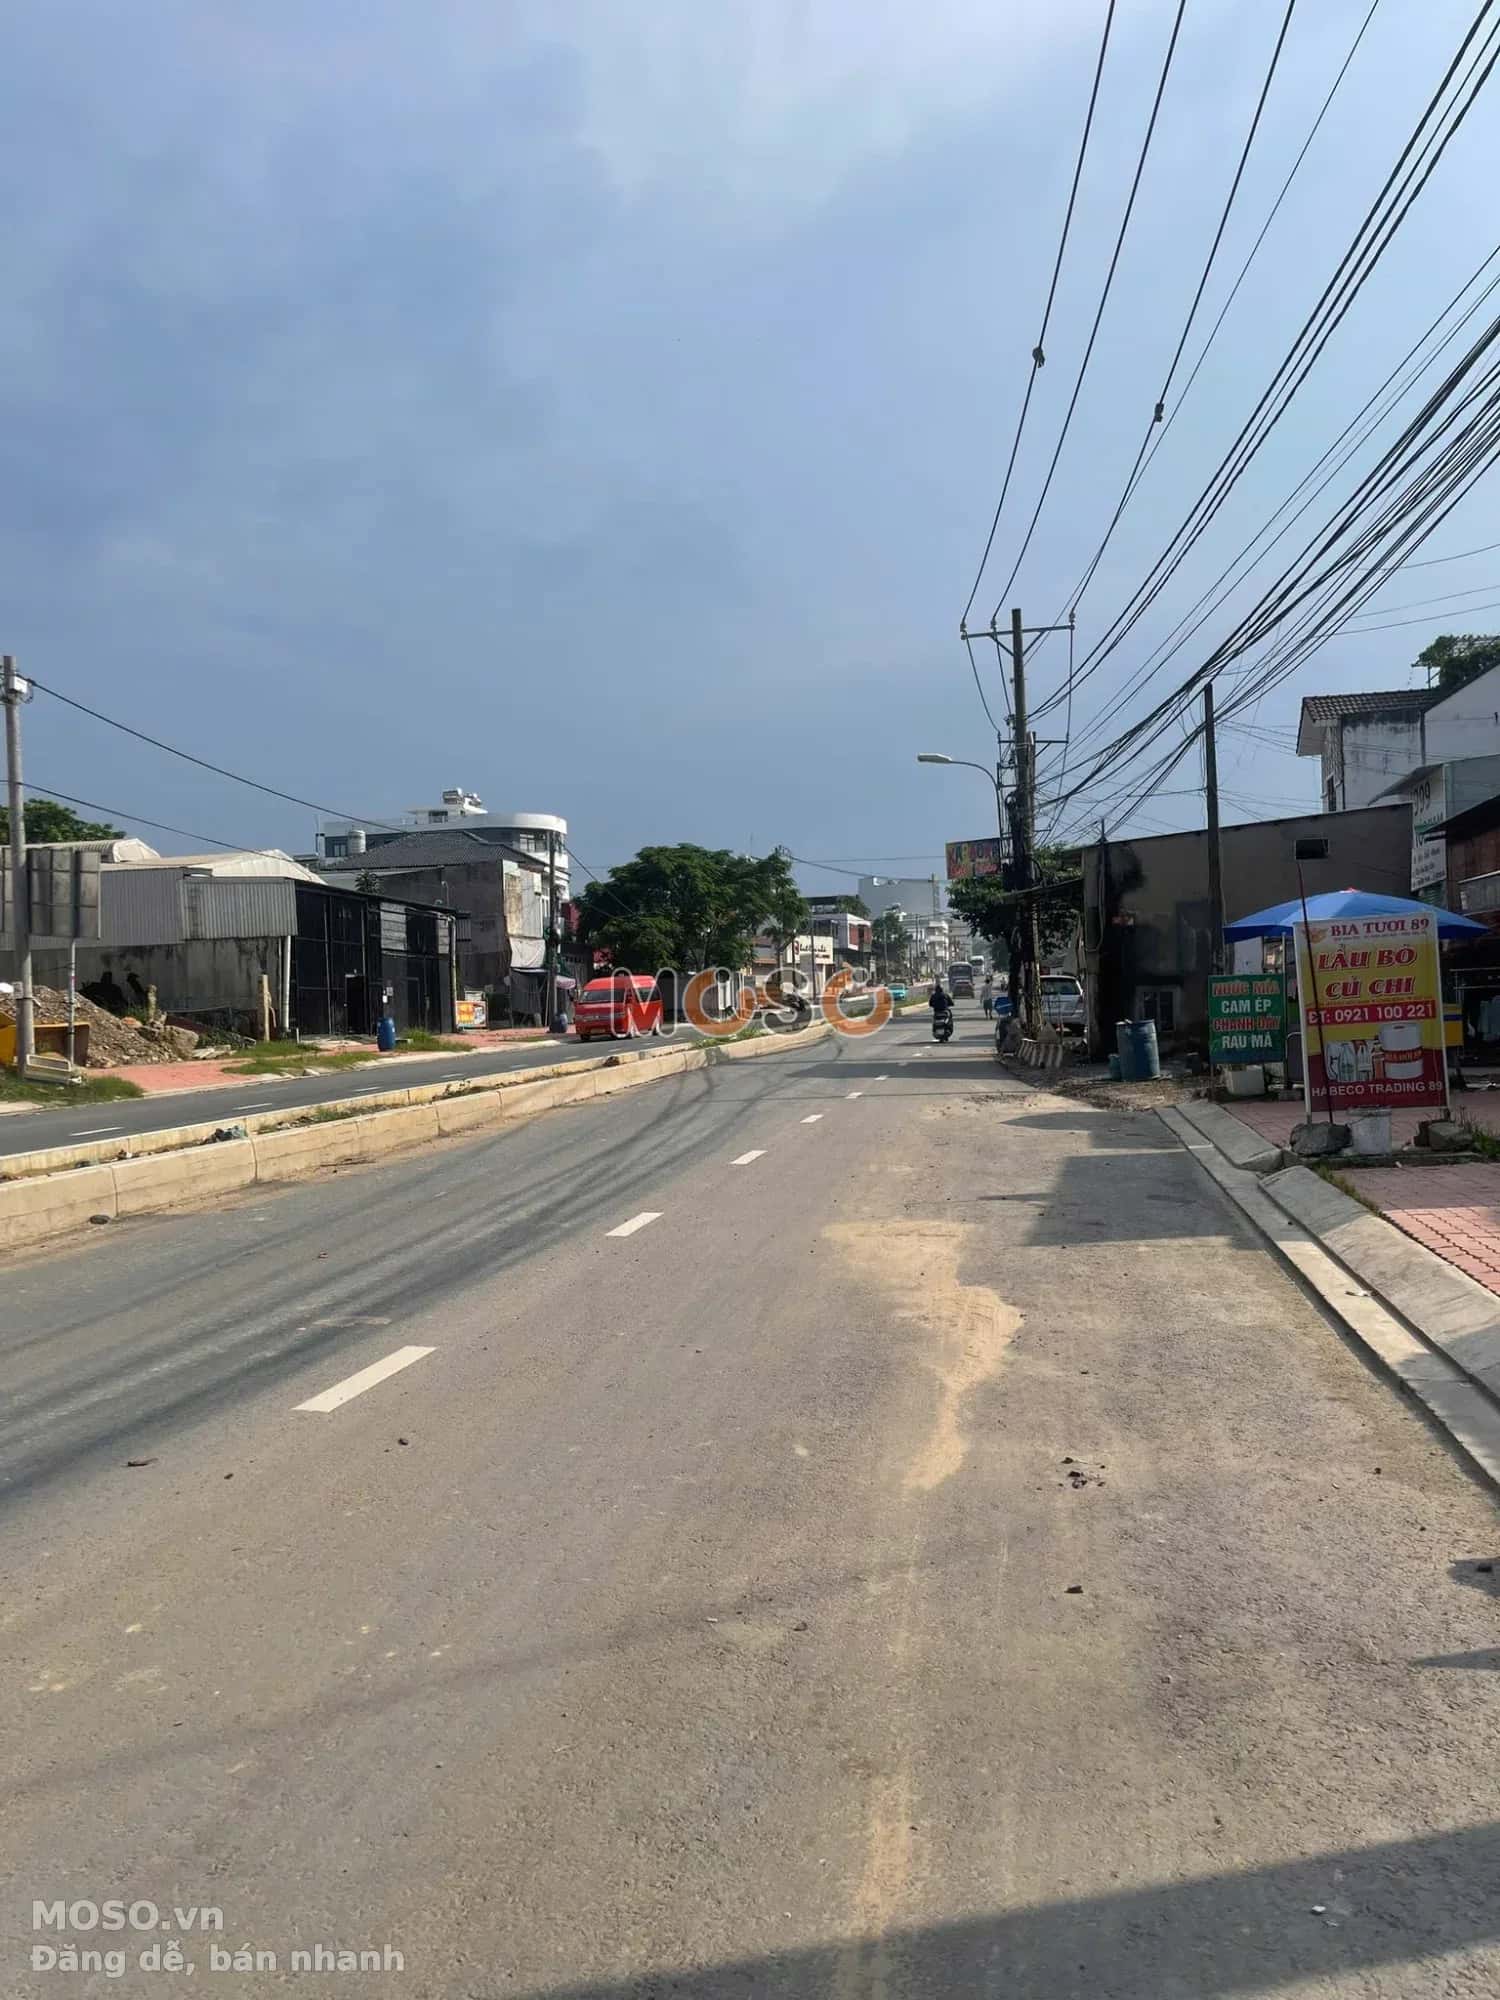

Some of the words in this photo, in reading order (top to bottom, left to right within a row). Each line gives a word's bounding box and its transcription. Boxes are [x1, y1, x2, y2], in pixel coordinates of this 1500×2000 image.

[1330, 923, 1360, 937] BIA
[1411, 918, 1430, 930] 89
[1368, 975, 1416, 996] CHI
[1221, 999, 1251, 1014] CAM
[1255, 996, 1272, 1013] ÉP
[1334, 1007, 1369, 1022] 0921
[1376, 1006, 1402, 1019] 100
[1407, 1004, 1432, 1018] 221
[1222, 1035, 1247, 1049] RAU
[1251, 1031, 1273, 1048] MÁ
[1311, 1084, 1365, 1097] HABECO
[1368, 1081, 1425, 1095] TRADING
[1428, 1080, 1443, 1092] 89
